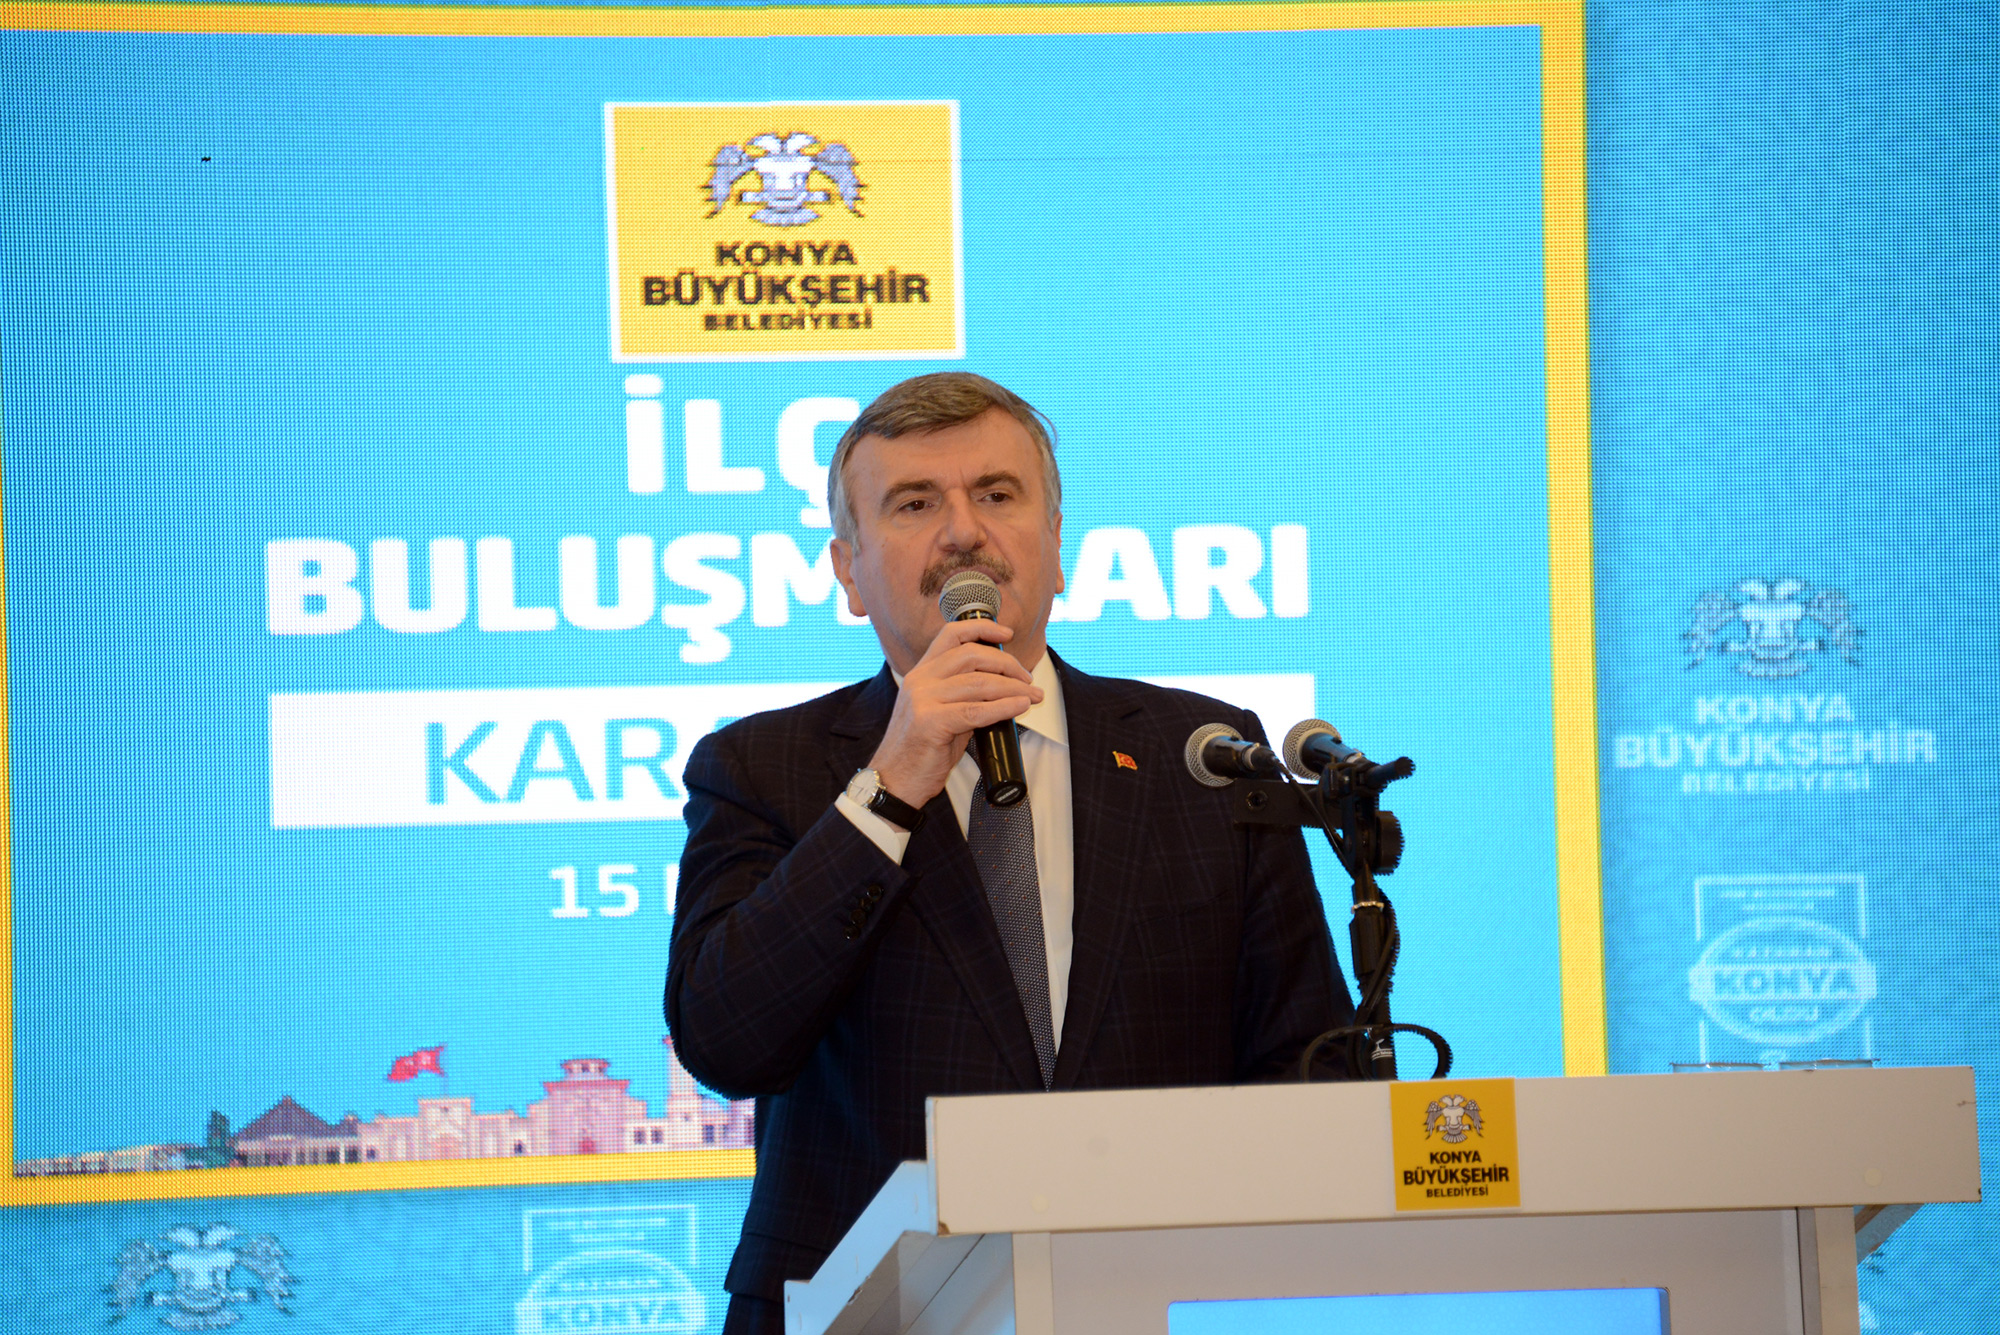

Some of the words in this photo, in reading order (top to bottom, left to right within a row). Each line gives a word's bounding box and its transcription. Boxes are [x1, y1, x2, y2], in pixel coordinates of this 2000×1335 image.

[715, 241, 858, 266] KONYA
[642, 267, 930, 308] BÜYÜKŞEHİR
[703, 308, 873, 331] BELEDİYESİ
[266, 523, 1309, 664] BULUŞMARI
[1696, 693, 1853, 724] KONYA
[1614, 722, 1938, 769] BÜYÜKŞEHİR
[549, 864, 640, 919] 15
[1713, 968, 1856, 997] KONYA
[1430, 1150, 1482, 1165] KONYA
[1403, 1164, 1510, 1187] BÜYÜKŞEHİR
[1426, 1184, 1489, 1198] BELEDİYESİ
[542, 1299, 687, 1331] KONYA
